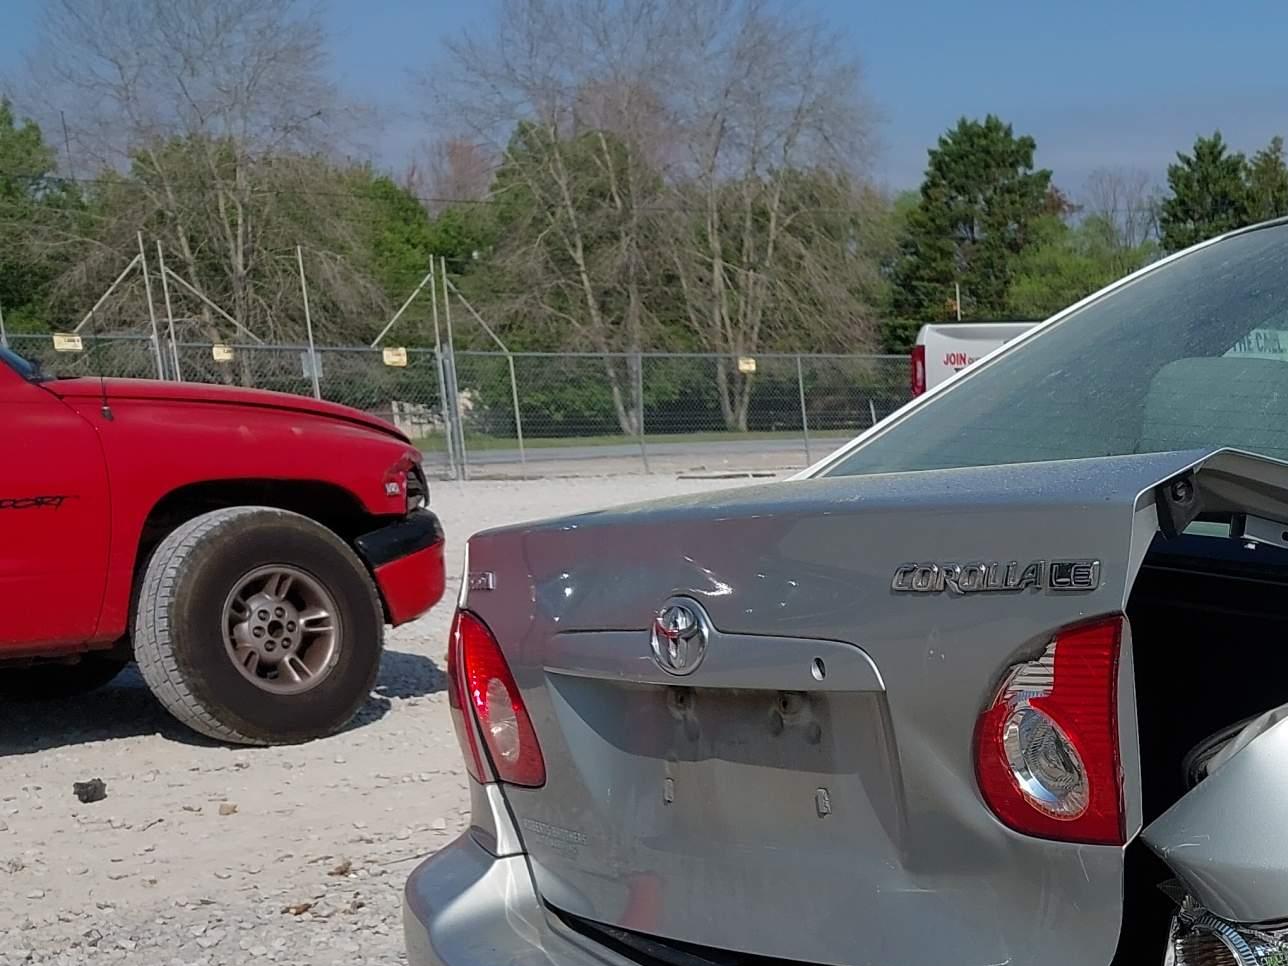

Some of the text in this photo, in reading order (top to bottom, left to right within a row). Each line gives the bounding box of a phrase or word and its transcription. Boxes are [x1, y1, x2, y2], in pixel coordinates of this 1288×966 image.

[943, 352, 967, 366] JOIN
[891, 560, 1101, 594] COROLLA LE
